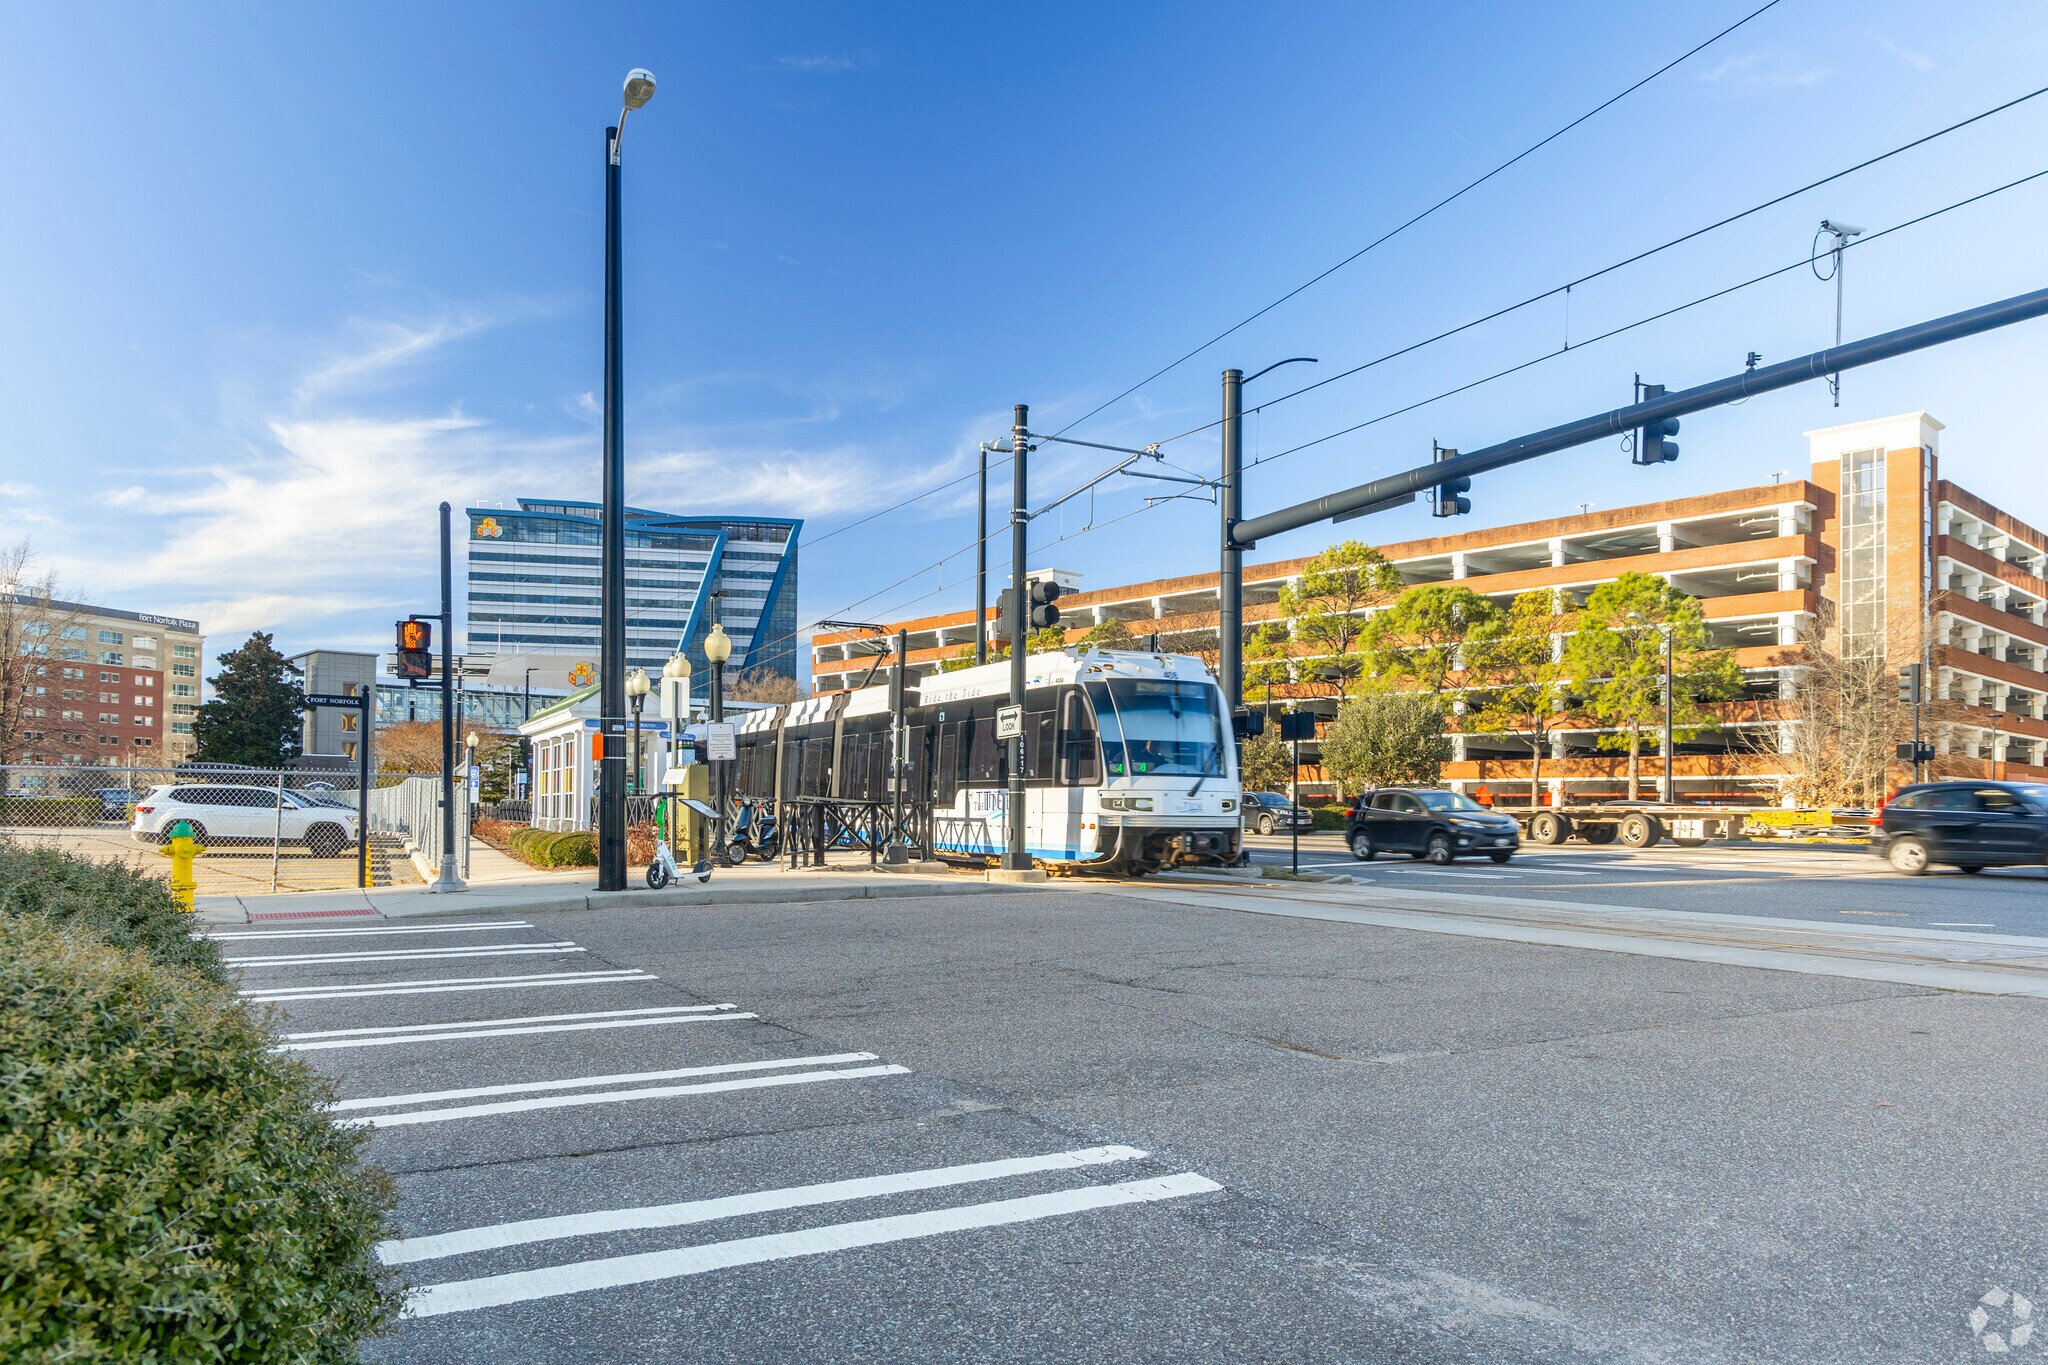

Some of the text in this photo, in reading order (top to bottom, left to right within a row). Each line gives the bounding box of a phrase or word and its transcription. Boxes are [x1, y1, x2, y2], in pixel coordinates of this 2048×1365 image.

[138, 613, 197, 628] Fort Norfolk Plaza
[924, 687, 981, 704] Ride the Tide
[1002, 722, 1015, 731] LOOK
